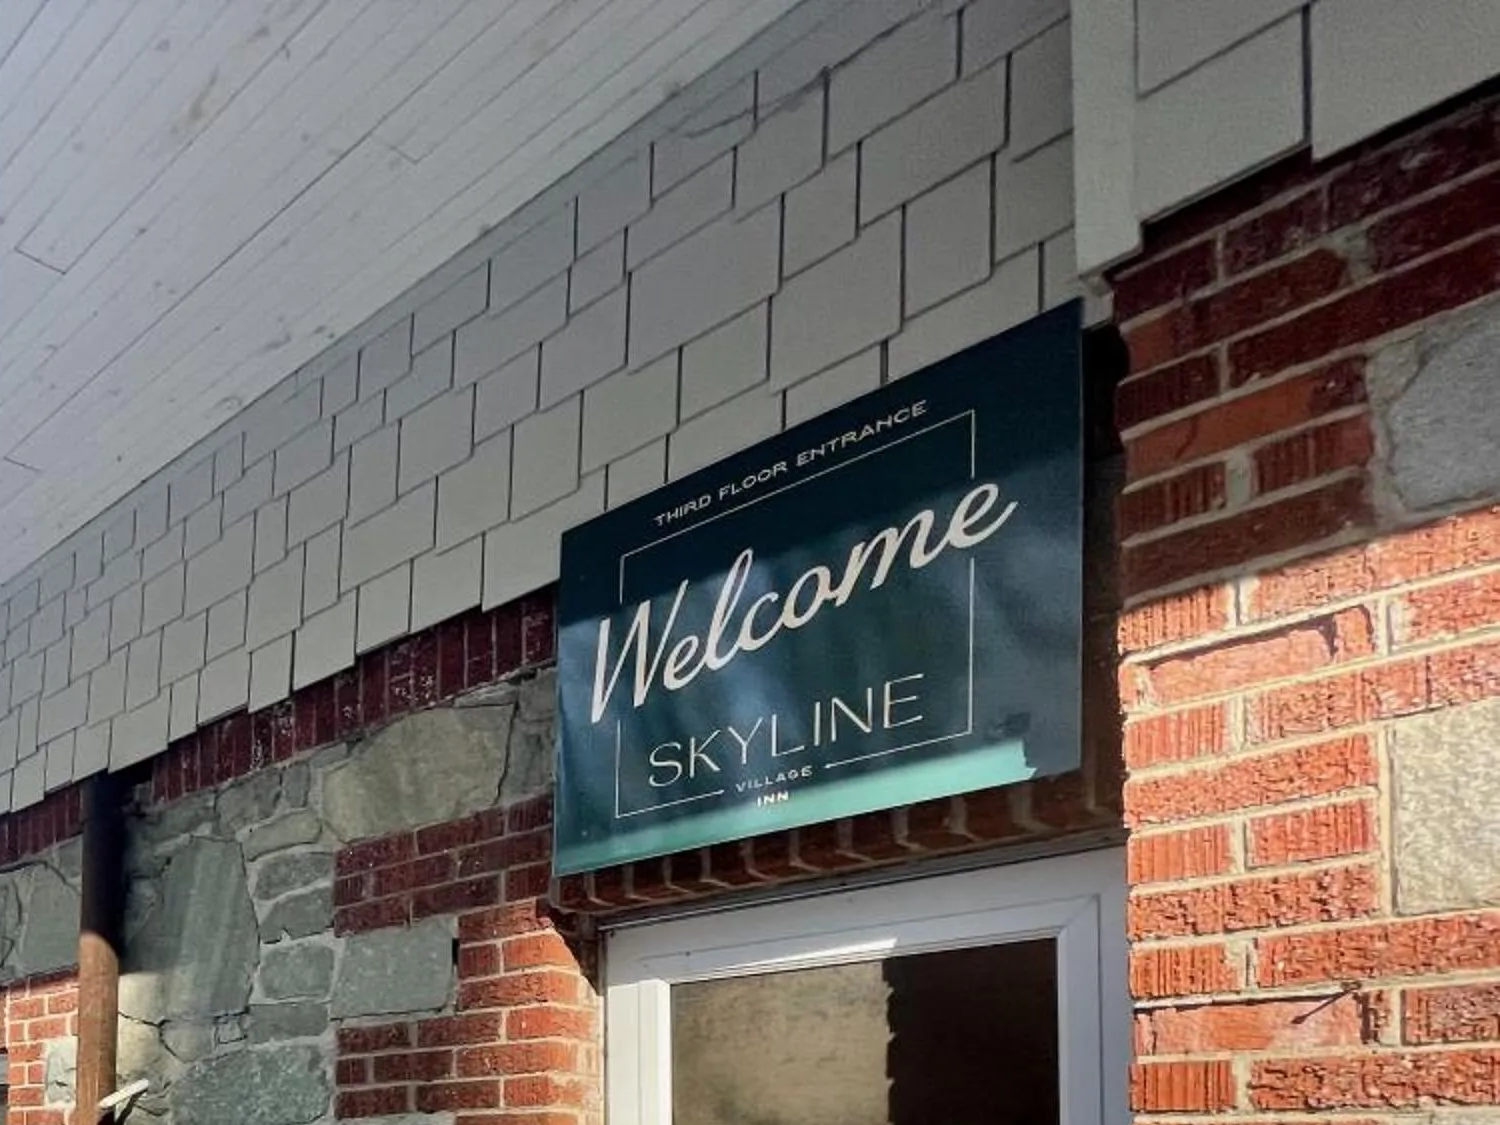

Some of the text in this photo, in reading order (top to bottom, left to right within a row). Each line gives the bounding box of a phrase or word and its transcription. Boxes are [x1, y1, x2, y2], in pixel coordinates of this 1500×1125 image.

[654, 400, 927, 526] THIRD FLOOR ENTRANCE
[591, 483, 1018, 722] Welcome
[649, 673, 924, 787] SKYLINE
[735, 765, 813, 792] VILLAGE
[757, 791, 789, 807] INN
